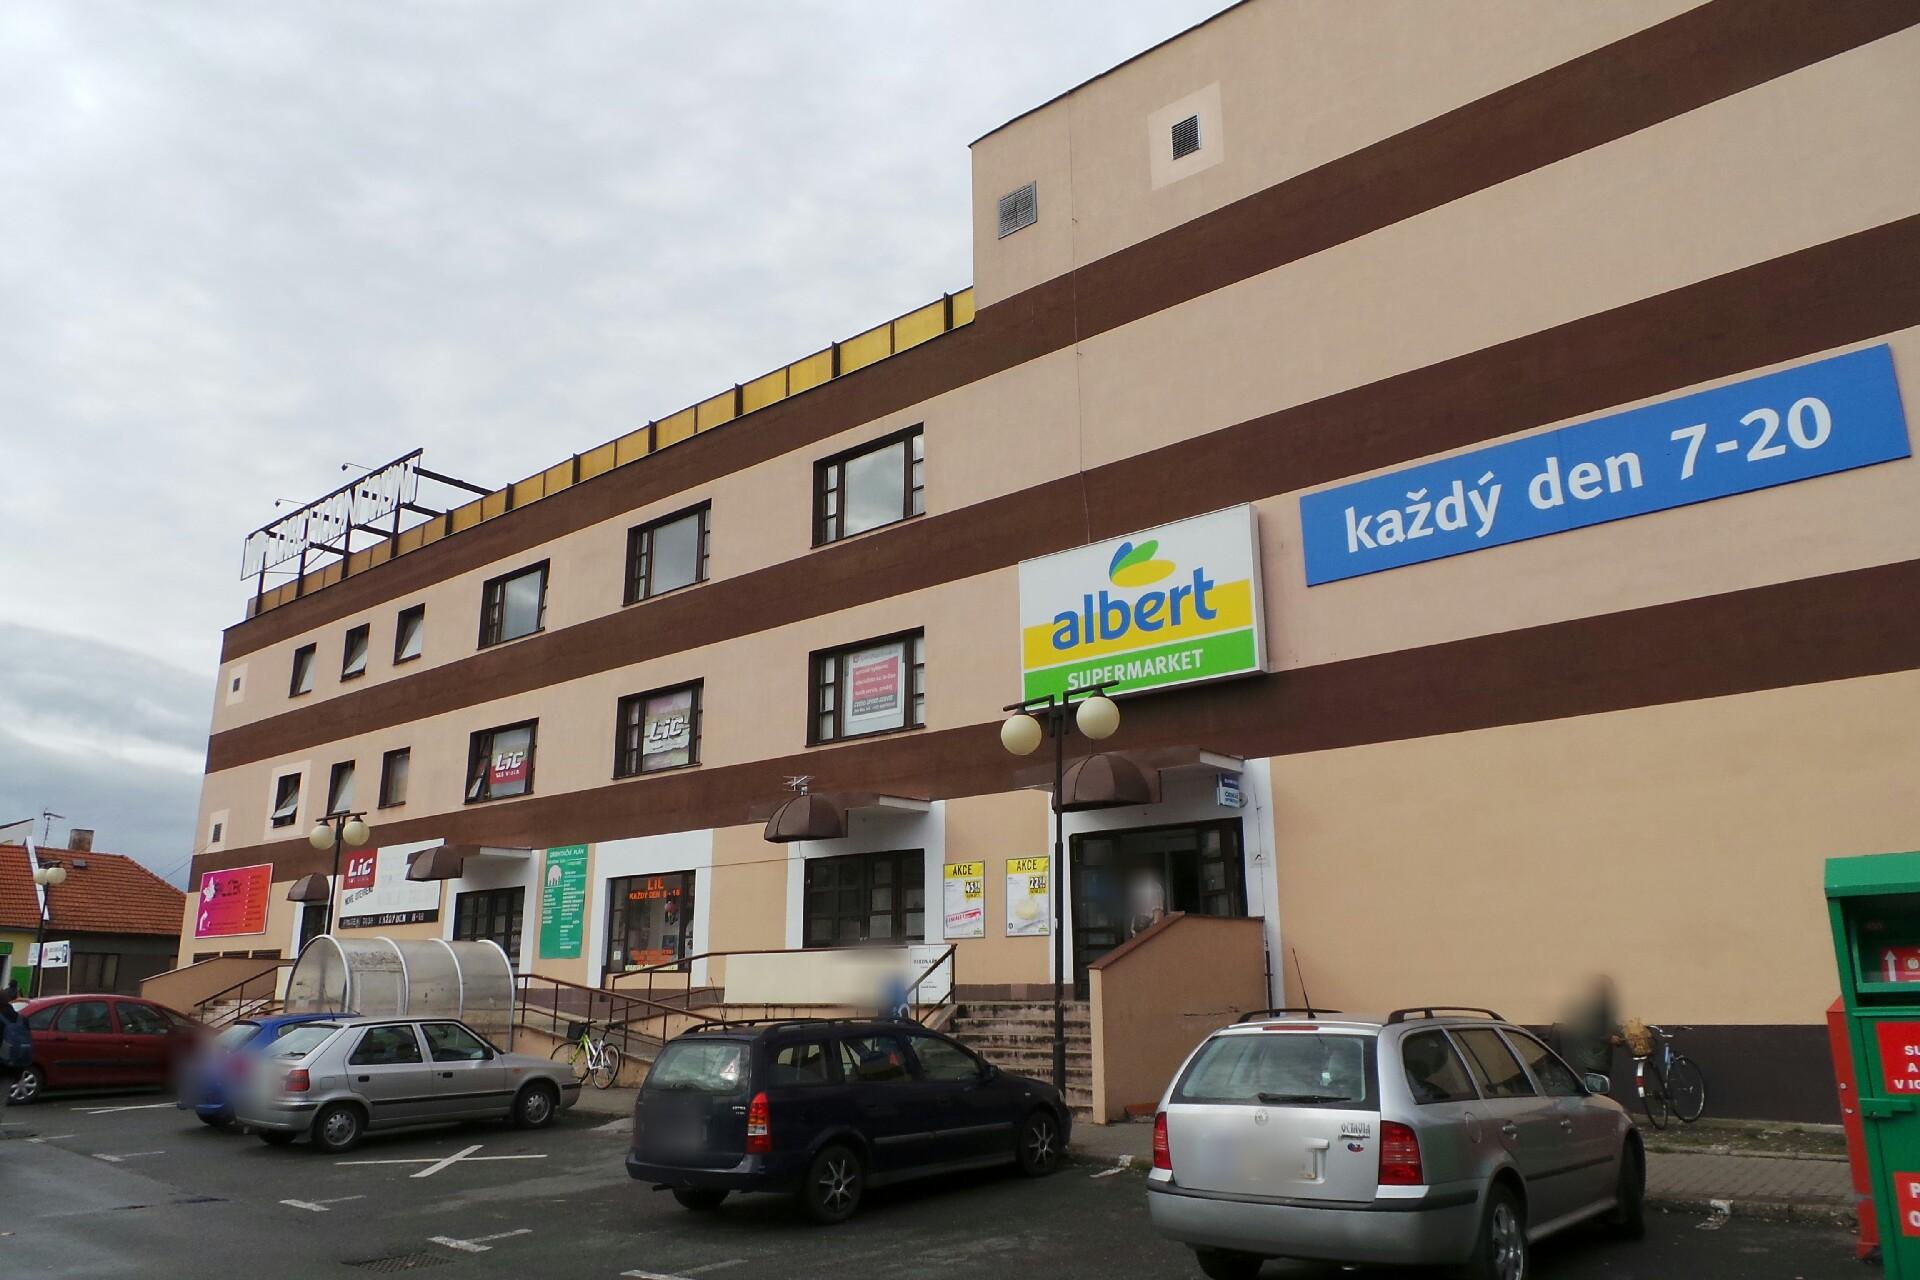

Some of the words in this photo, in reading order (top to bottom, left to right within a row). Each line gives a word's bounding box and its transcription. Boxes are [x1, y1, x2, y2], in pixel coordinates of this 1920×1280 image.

[1344, 470, 1503, 554] každý
[1527, 456, 1644, 511] den
[1669, 396, 1833, 481] 7-20
[1052, 566, 1218, 651] albert
[1067, 648, 1204, 691] SUPERMARKET
[952, 864, 973, 876] AKCE
[1016, 859, 1038, 872] AKCE
